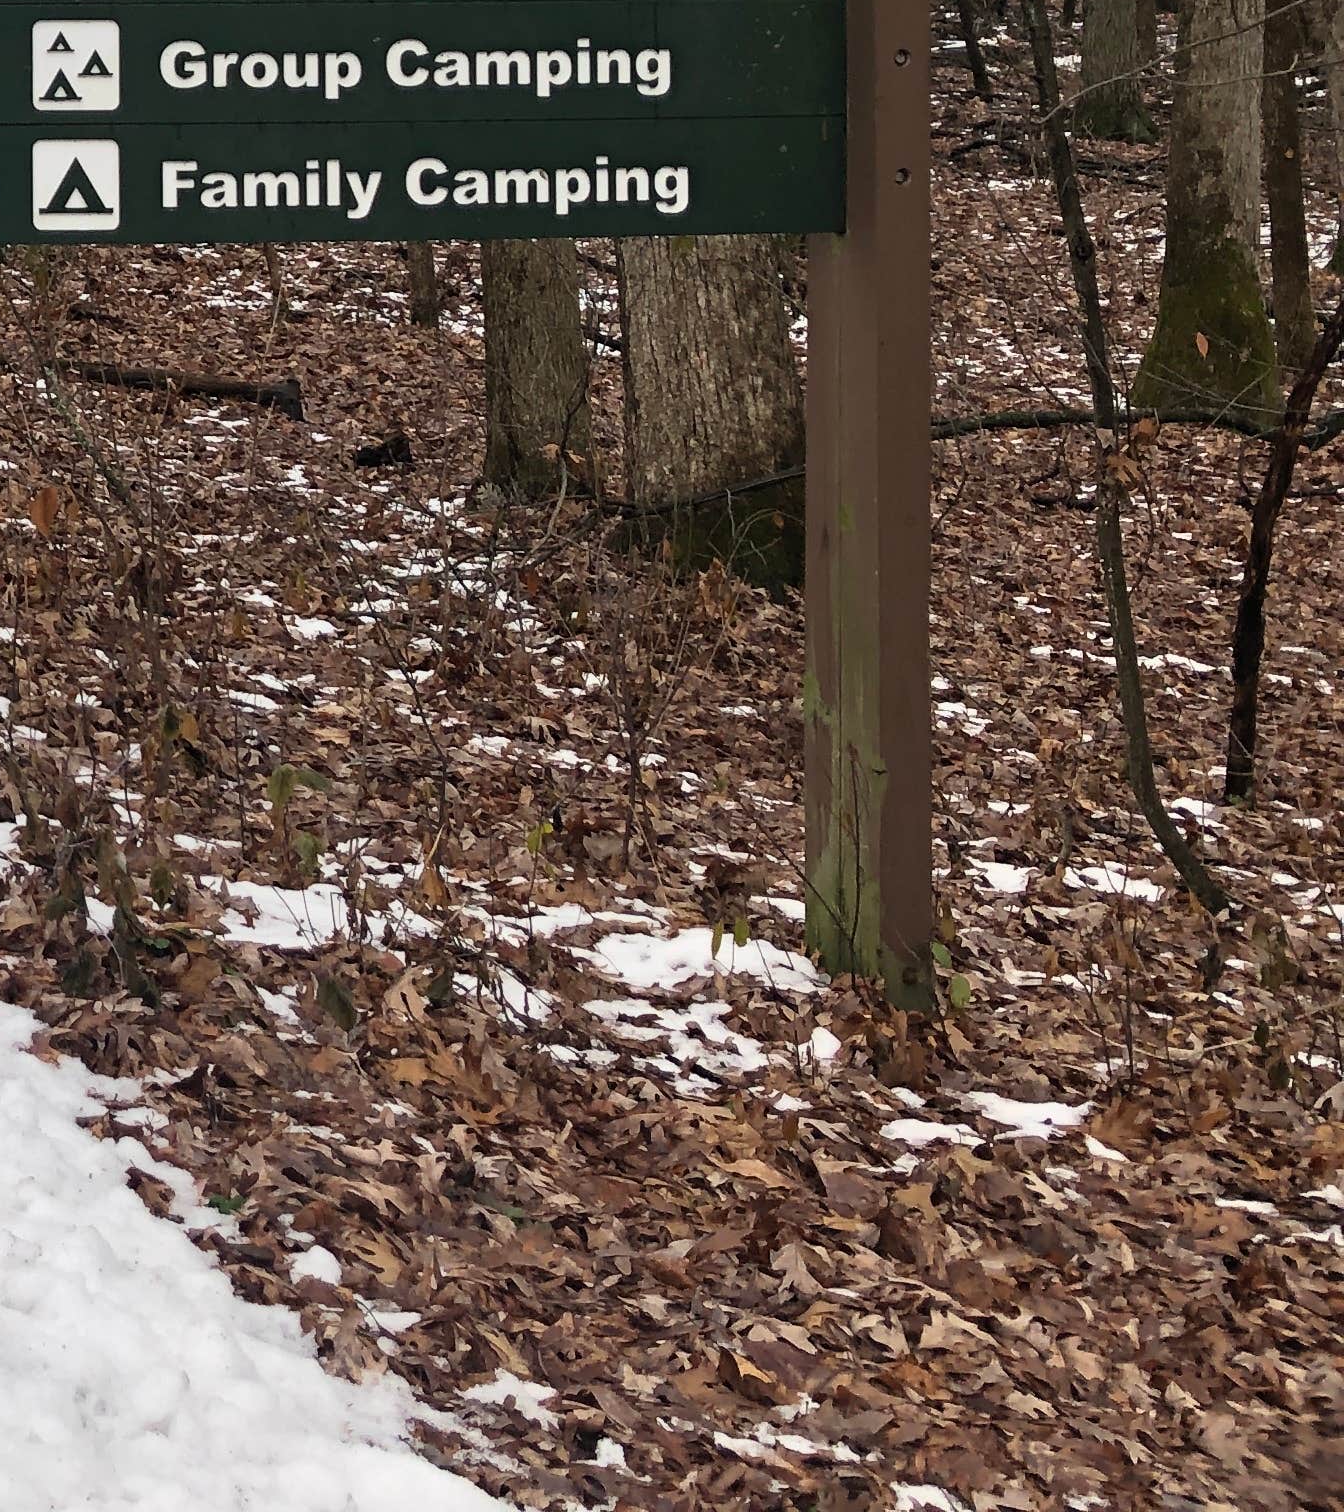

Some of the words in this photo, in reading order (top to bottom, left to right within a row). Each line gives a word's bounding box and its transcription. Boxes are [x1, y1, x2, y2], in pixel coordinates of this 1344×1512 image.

[158, 39, 363, 101] Group
[385, 37, 672, 98] Camping
[161, 158, 383, 220] Family
[404, 155, 690, 216] Camping
